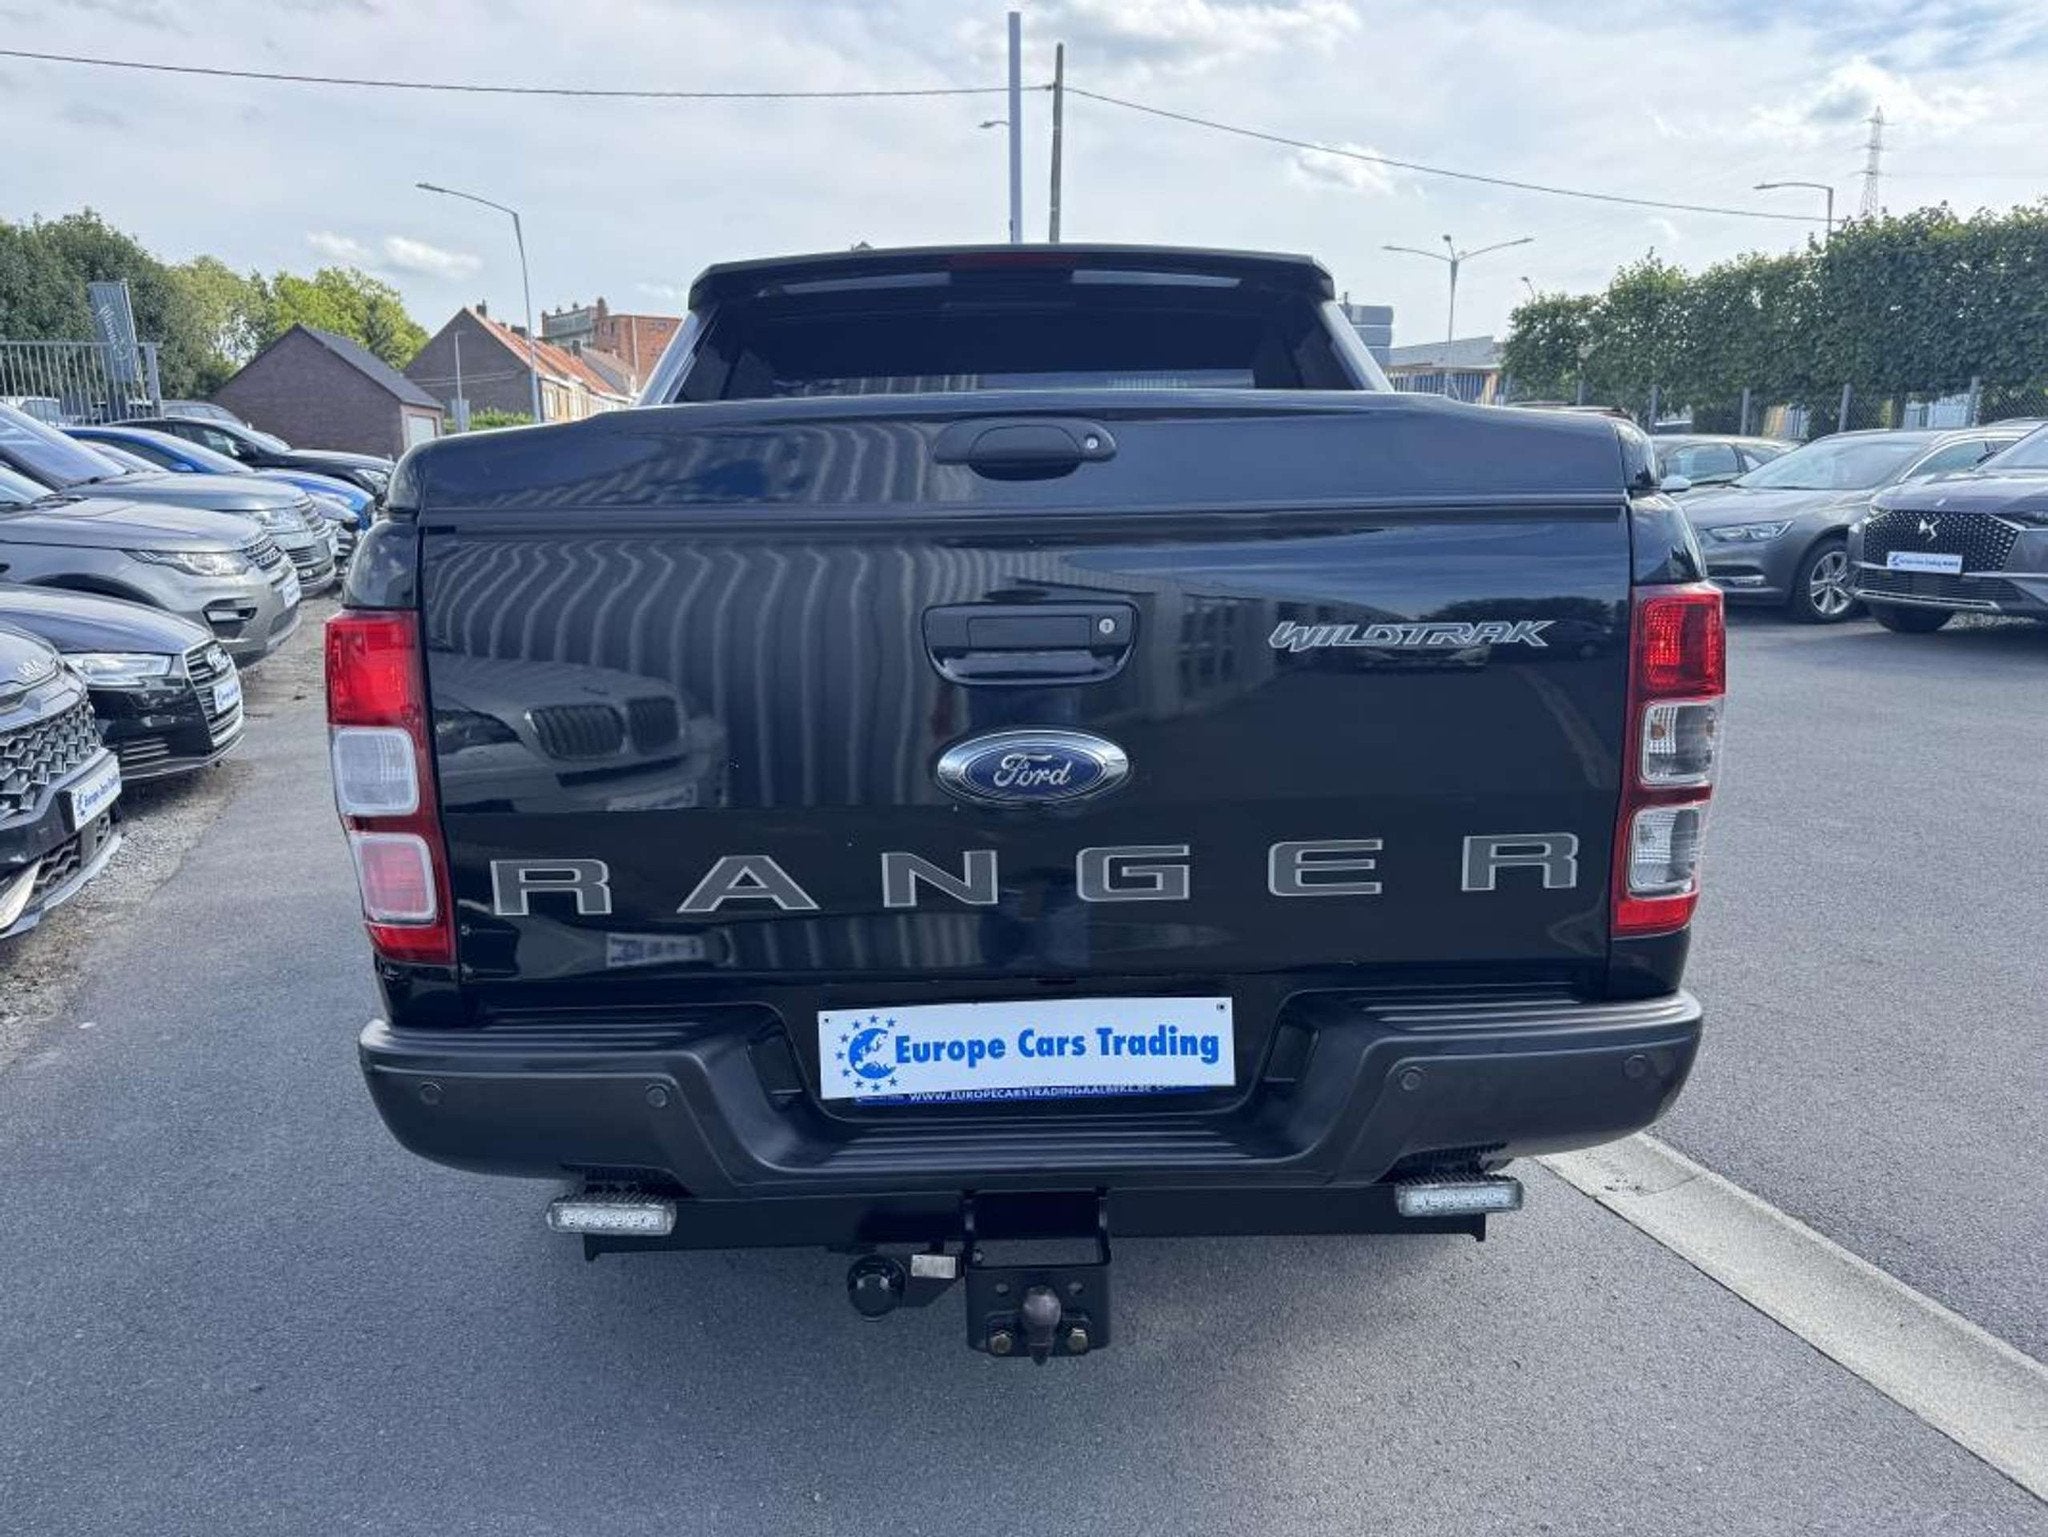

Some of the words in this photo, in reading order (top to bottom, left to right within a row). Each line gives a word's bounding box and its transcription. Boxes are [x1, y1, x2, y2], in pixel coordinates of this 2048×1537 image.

[1268, 620, 1556, 652] WILDTRAK
[993, 753, 1073, 787] Ford
[489, 832, 1579, 916] RANGER
[895, 1034, 1006, 1068] Europe
[1018, 1028, 1086, 1058] Cars
[1097, 1025, 1220, 1065] Trading
